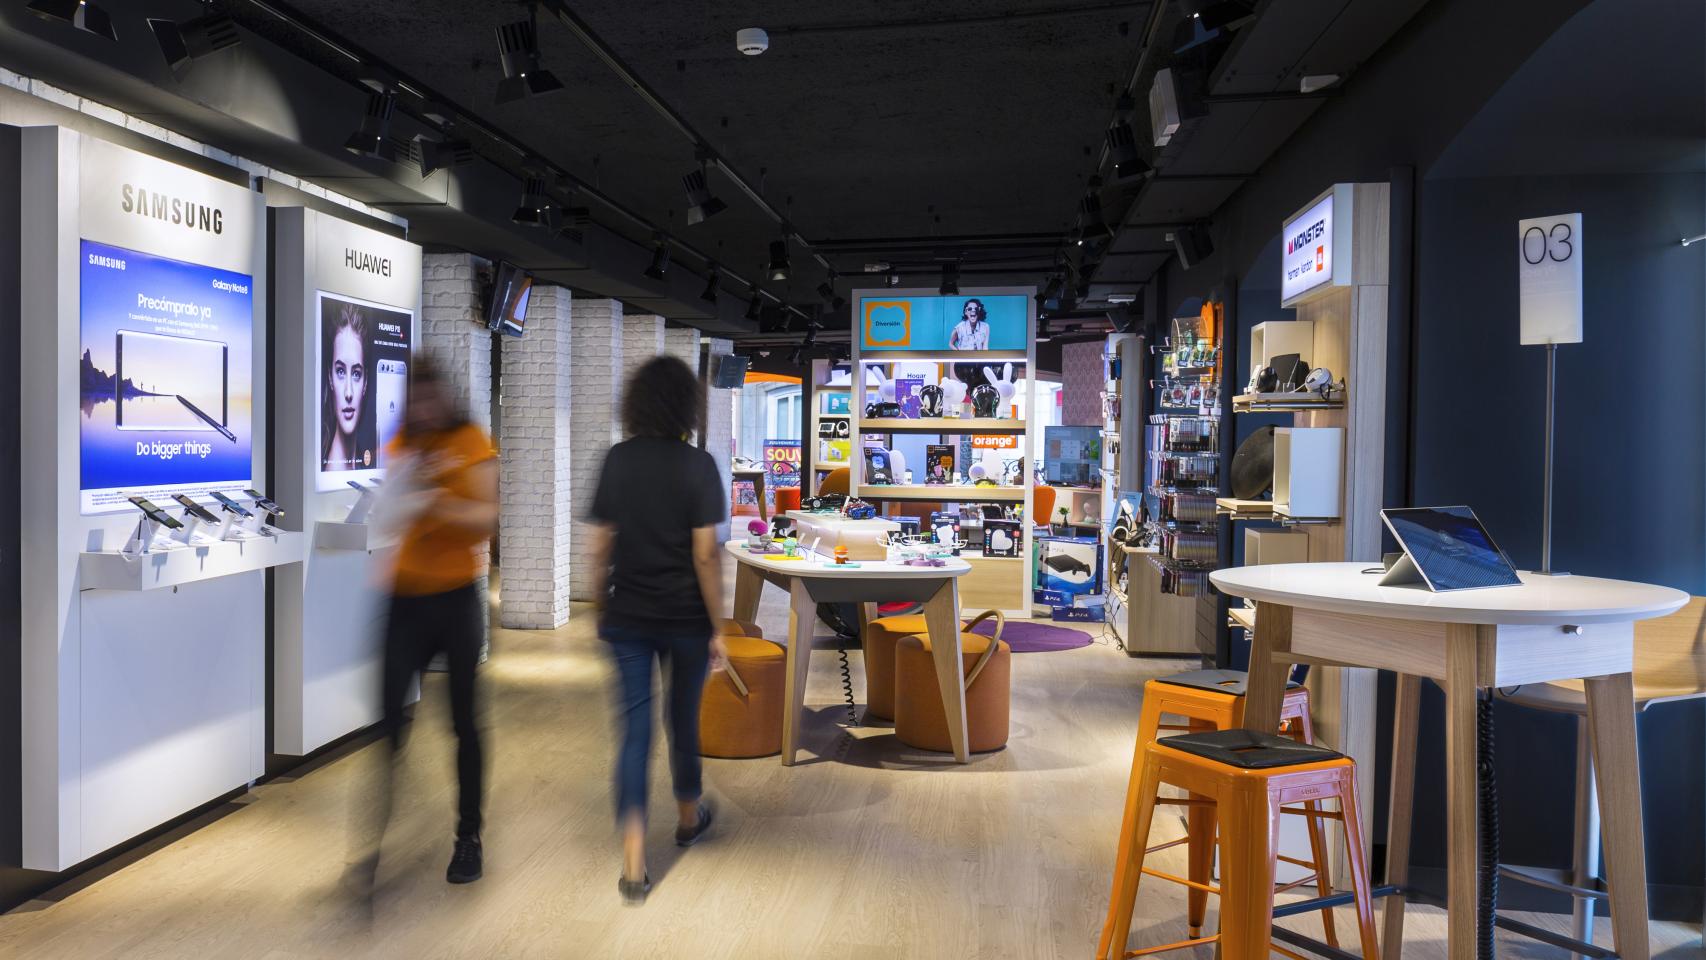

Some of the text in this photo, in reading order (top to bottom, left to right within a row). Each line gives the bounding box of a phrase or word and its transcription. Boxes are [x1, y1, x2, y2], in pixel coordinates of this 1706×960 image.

[122, 183, 223, 235] SAMSUNG
[1294, 219, 1325, 252] MONSTER
[1523, 223, 1573, 265] 03
[88, 253, 126, 271] SAMSUNG
[345, 247, 392, 278] HUAWEI
[212, 279, 248, 294] Galaxy Note8
[137, 293, 212, 321] Precómpralo ya
[378, 322, 394, 332] HUAWEI
[136, 440, 212, 460] Do bigger things
[974, 437, 1012, 448] orange
